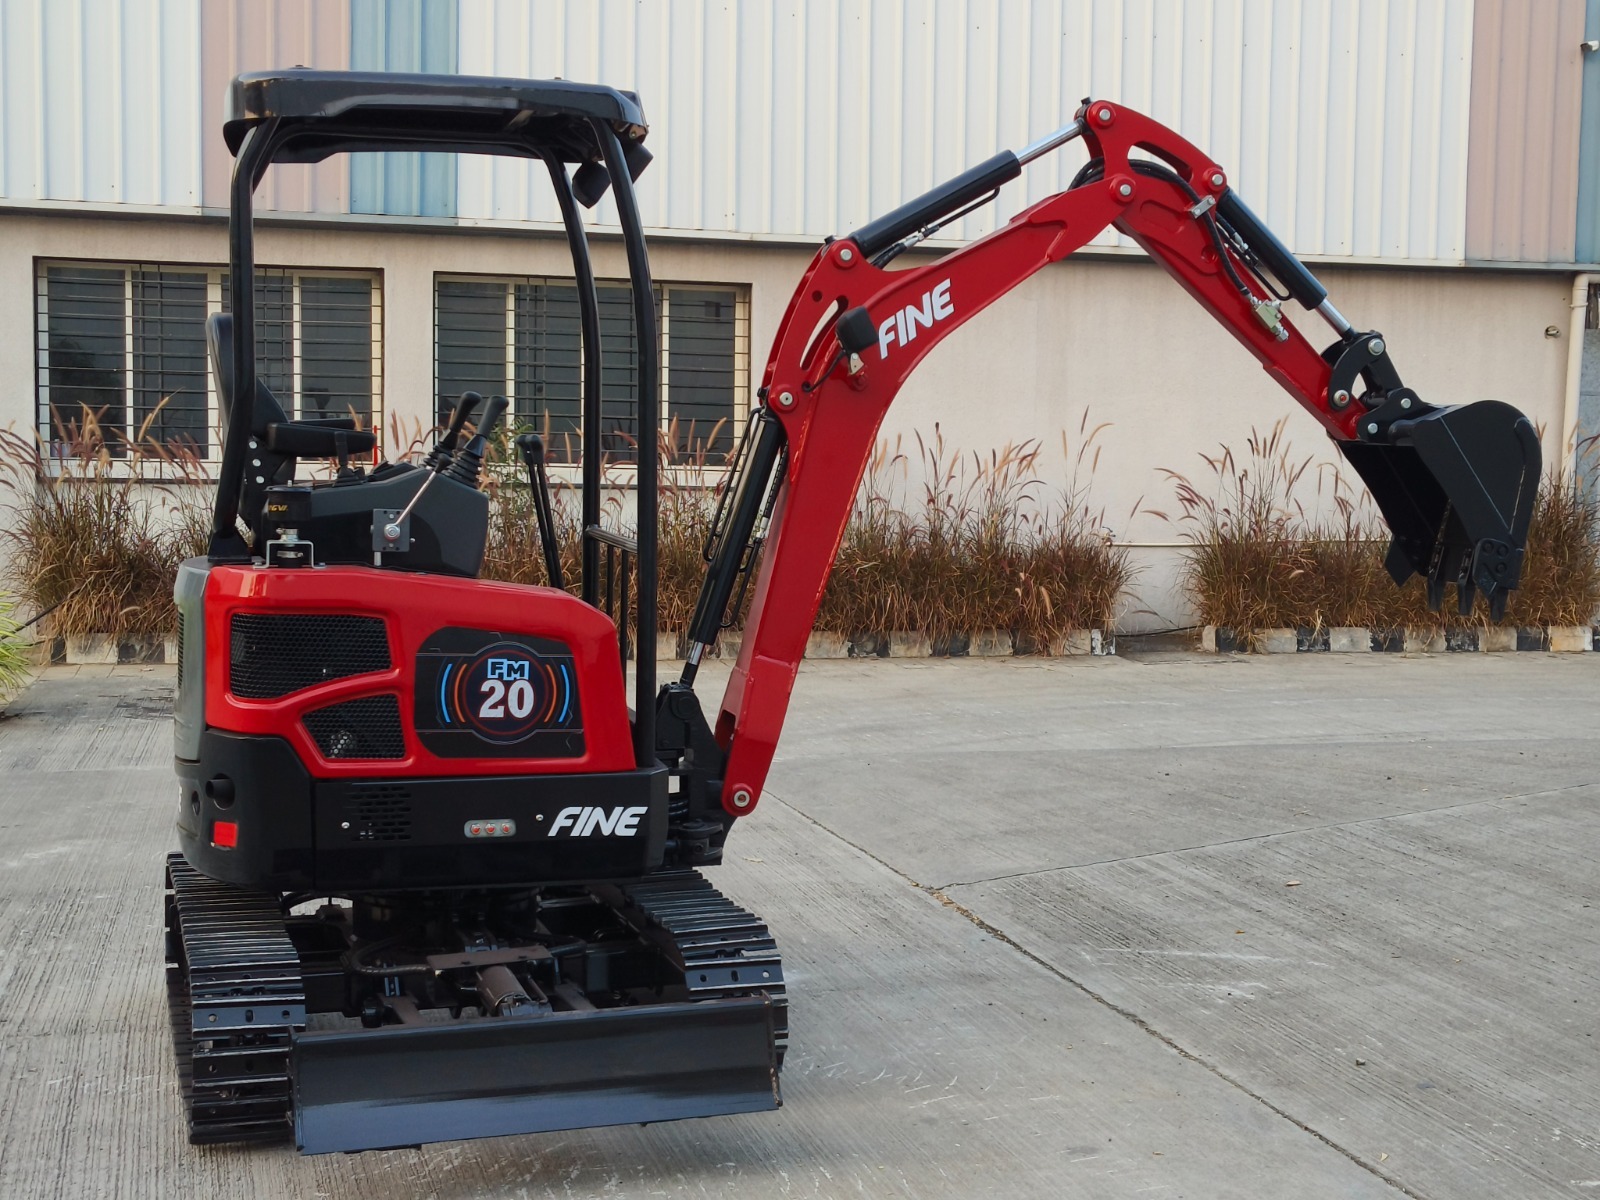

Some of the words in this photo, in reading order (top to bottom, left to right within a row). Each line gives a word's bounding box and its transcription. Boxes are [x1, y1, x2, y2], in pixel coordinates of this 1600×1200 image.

[878, 277, 955, 360] FINE
[487, 658, 530, 681] FM
[479, 679, 534, 718] 20
[547, 806, 649, 837] FINE
